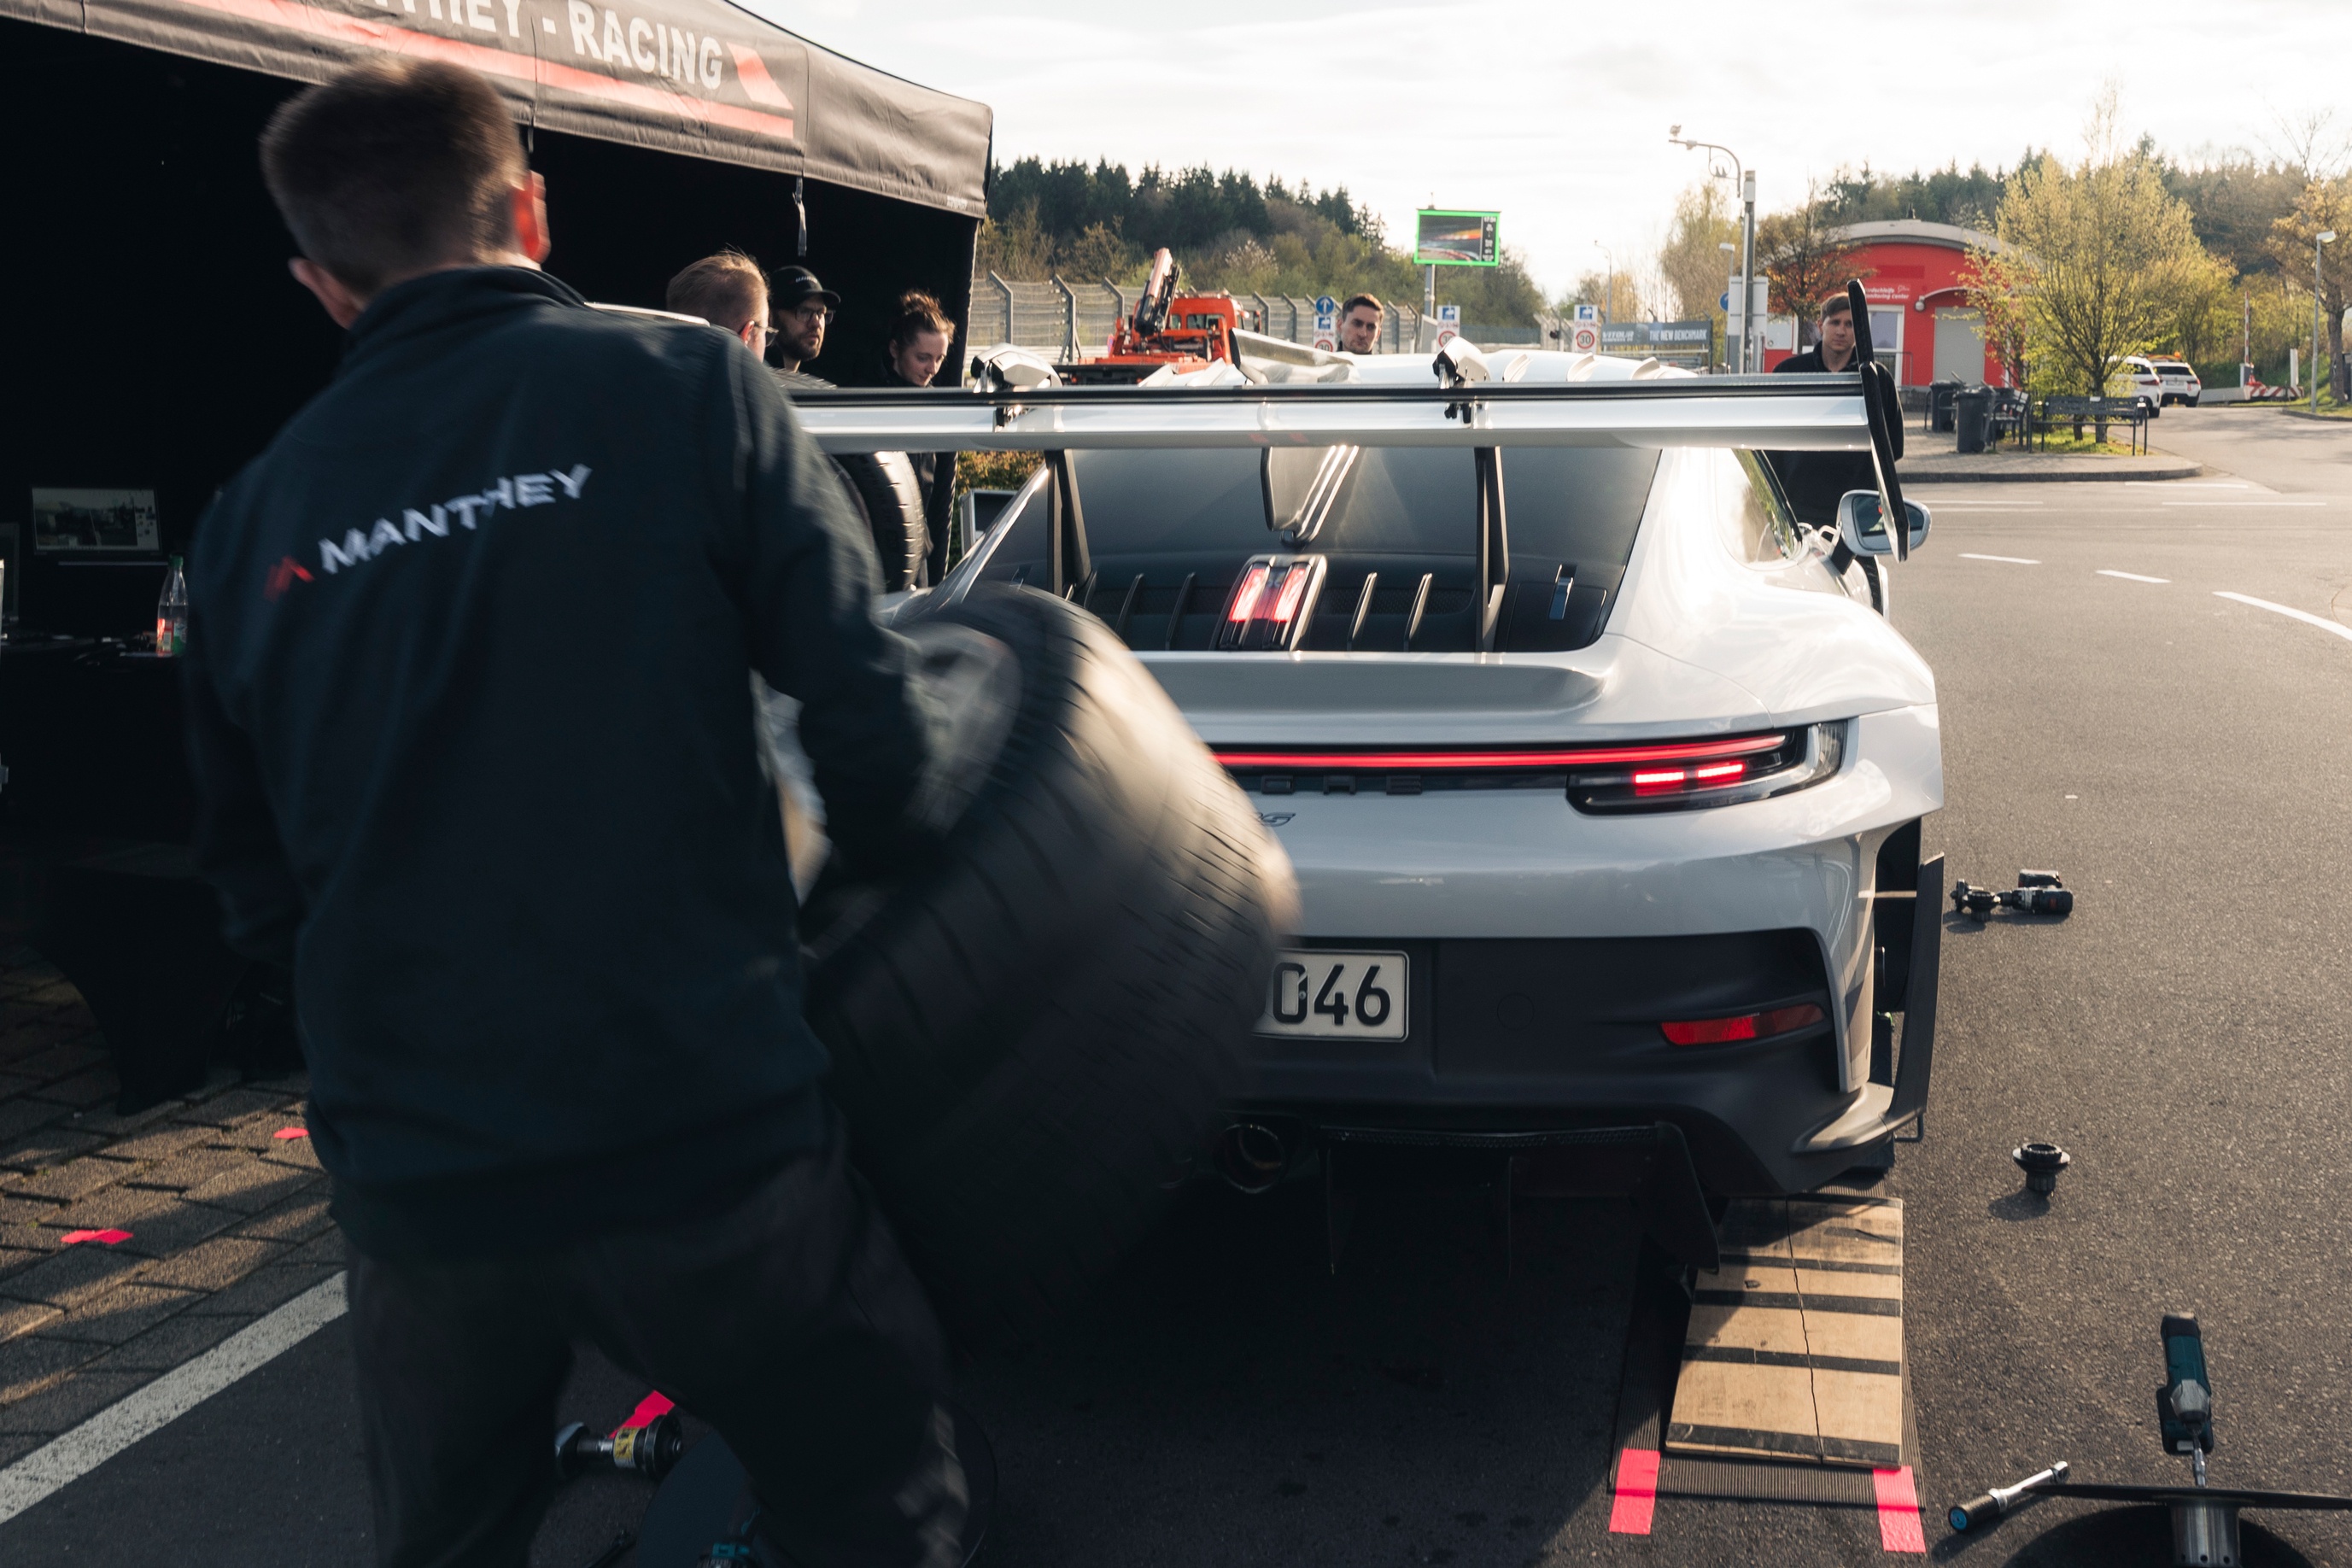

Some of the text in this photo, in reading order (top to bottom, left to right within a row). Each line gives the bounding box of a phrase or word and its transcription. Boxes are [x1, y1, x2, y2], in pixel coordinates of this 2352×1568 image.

[568, 0, 723, 90] RACING
[1580, 335, 1590, 344] 30
[1649, 329, 1707, 342] THE NEW BENCHMARK
[318, 463, 593, 575] MANTHEY
